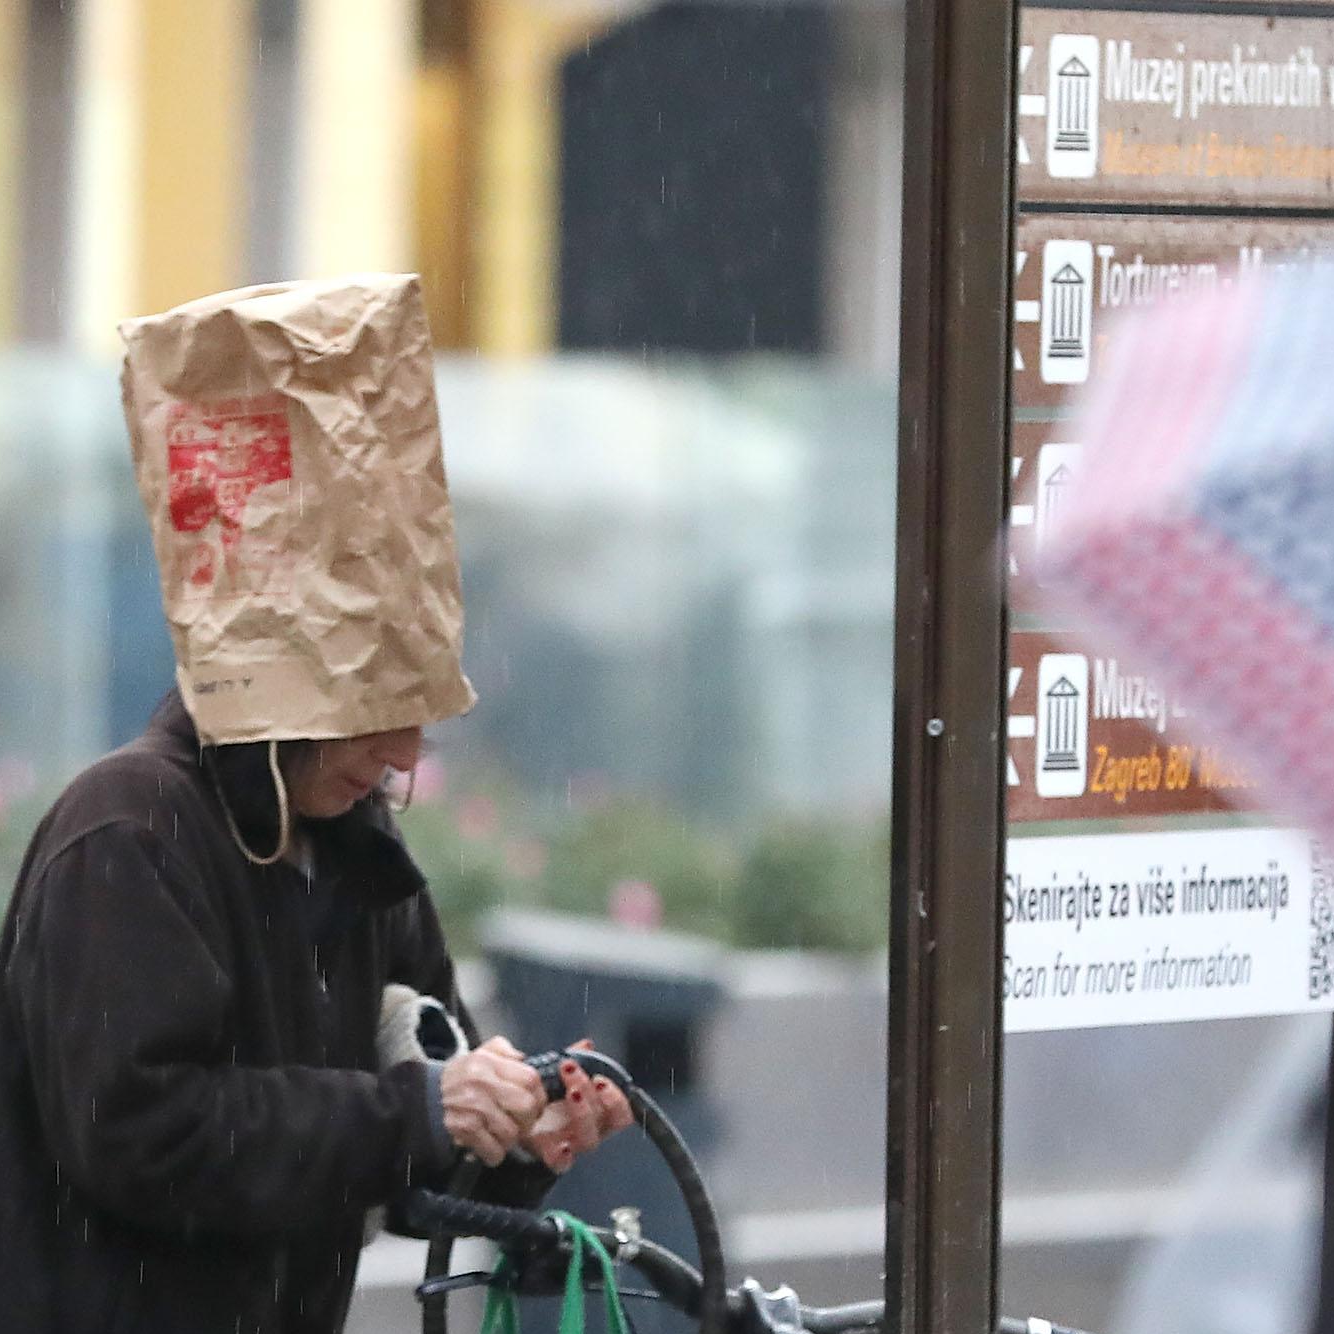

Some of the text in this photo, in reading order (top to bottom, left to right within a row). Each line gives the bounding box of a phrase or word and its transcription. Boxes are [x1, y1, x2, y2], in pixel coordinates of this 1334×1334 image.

[1103, 39, 1185, 119] Muzej
[1189, 43, 1322, 119] prekinutih
[1089, 743, 1163, 803] Zagreb
[1003, 860, 1290, 934] Skenirajte za više informacija
[1003, 943, 1253, 1000] Scan for more information
